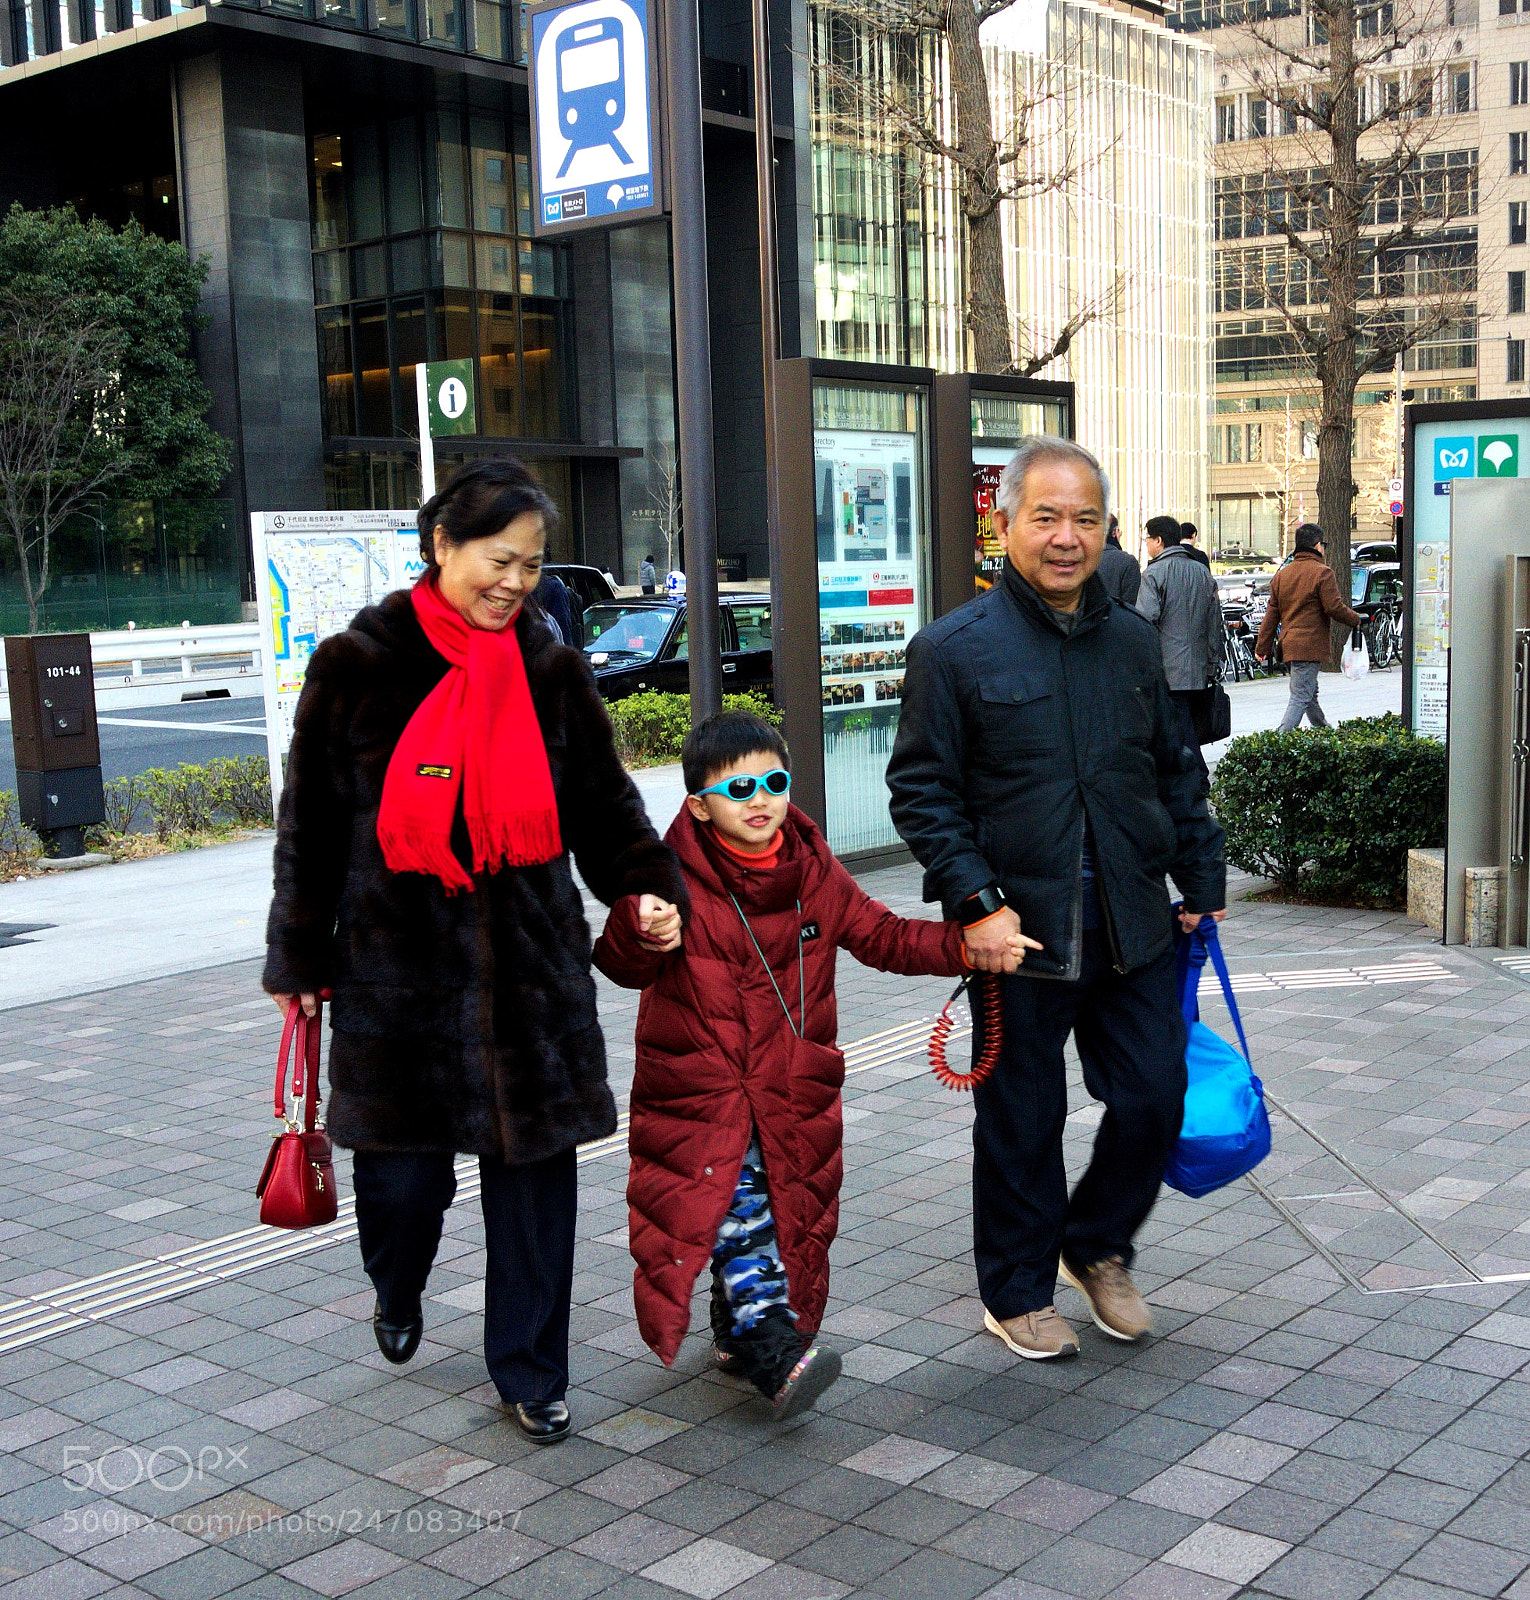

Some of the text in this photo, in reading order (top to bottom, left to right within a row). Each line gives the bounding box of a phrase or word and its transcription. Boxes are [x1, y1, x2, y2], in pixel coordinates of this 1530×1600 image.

[976, 514, 992, 538] 地
[981, 557, 1005, 571] 2018.2.1
[47, 666, 80, 677] 101-44
